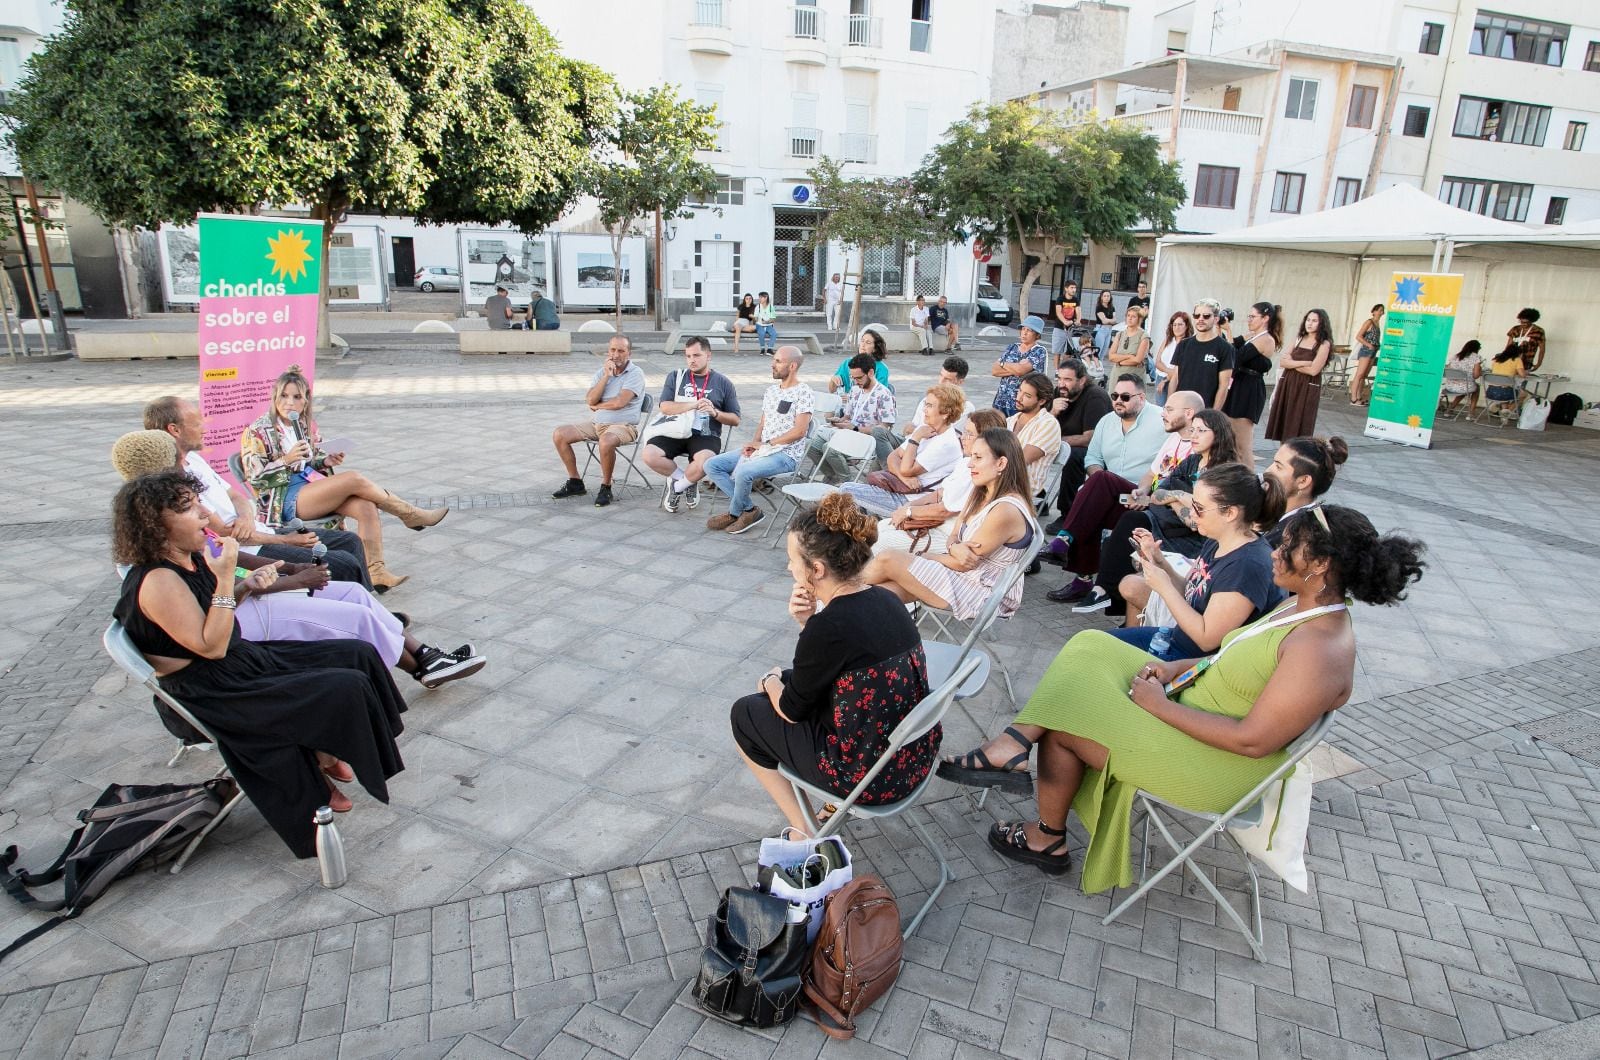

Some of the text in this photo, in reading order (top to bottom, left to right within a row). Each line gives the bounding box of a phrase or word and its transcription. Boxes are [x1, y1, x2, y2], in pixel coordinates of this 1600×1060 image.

[204, 278, 286, 298] charlas
[338, 287, 350, 298] 13
[205, 304, 290, 327] sobre el
[1390, 303, 1453, 314] creatividad
[204, 331, 306, 356] escenario
